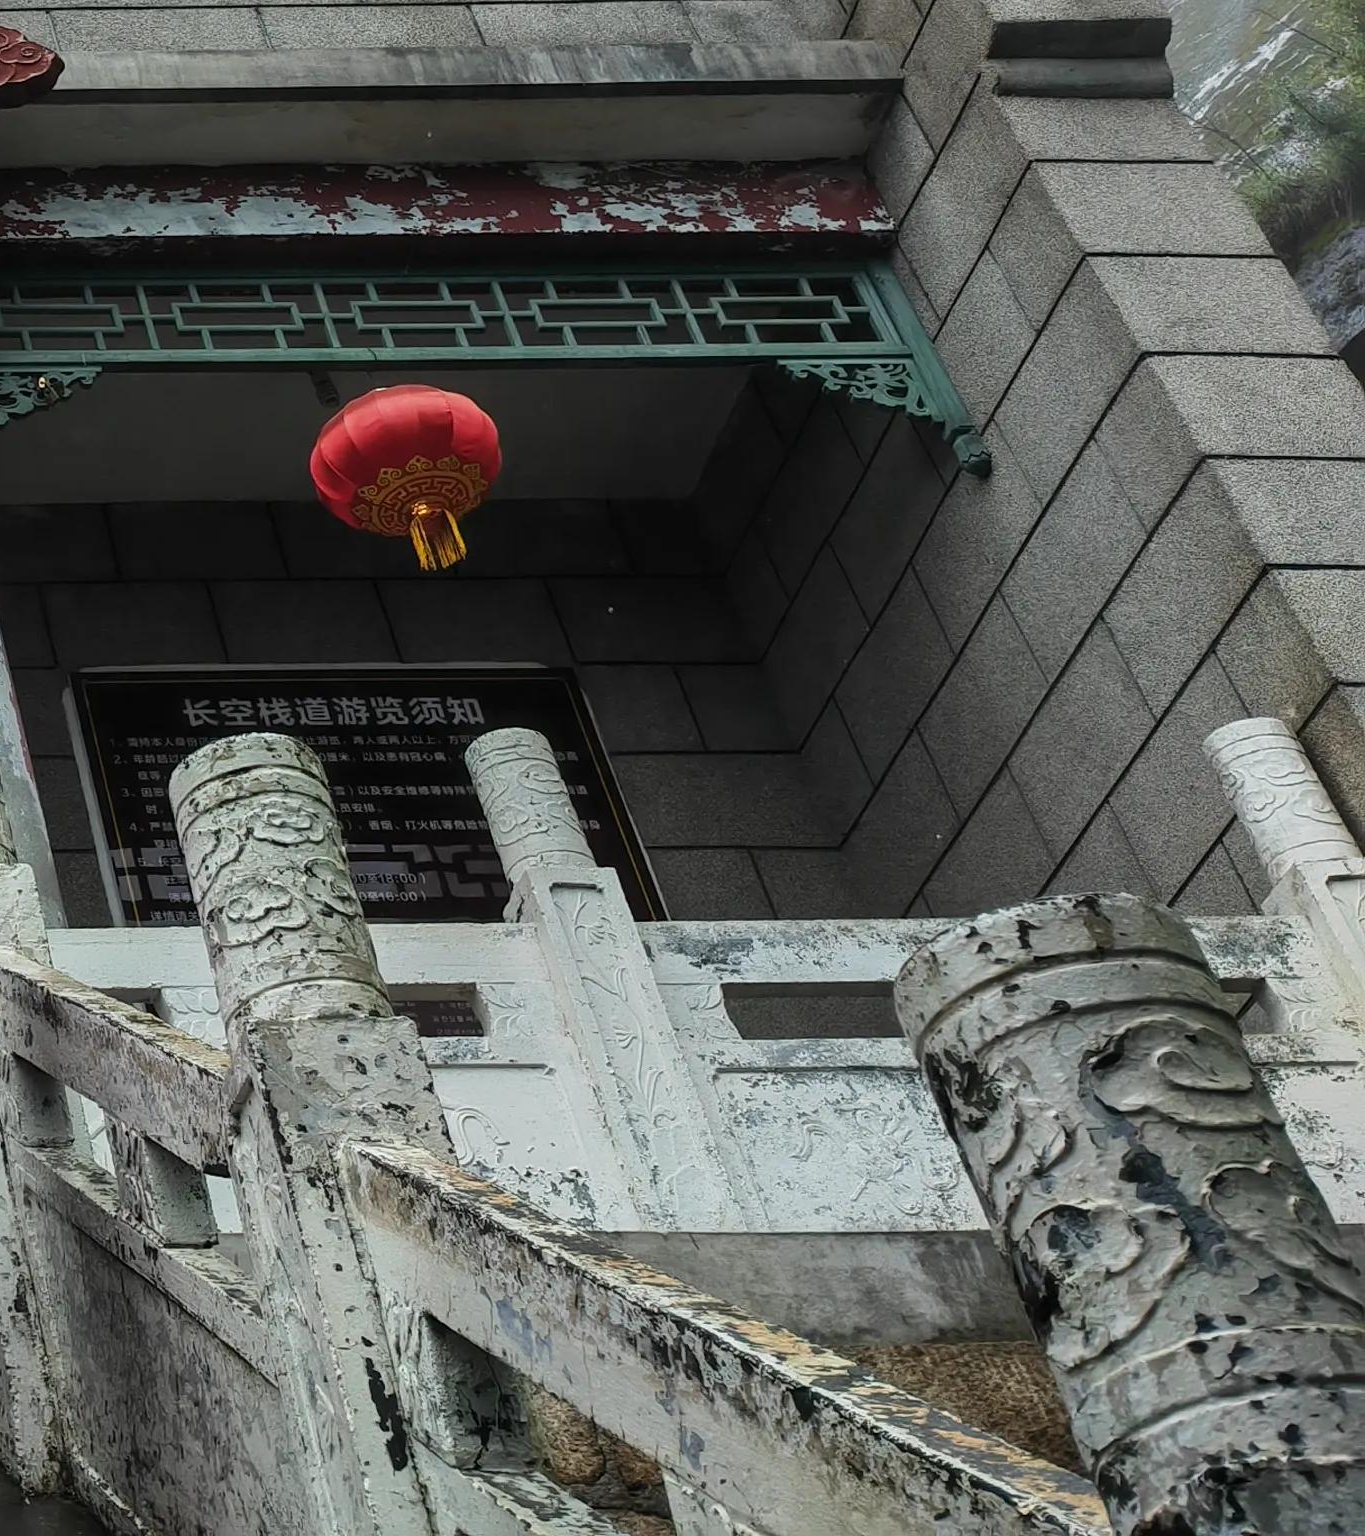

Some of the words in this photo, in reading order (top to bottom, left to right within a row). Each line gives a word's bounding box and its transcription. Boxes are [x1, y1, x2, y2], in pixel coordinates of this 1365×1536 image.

[183, 696, 486, 728] 长空栈道游览须知
